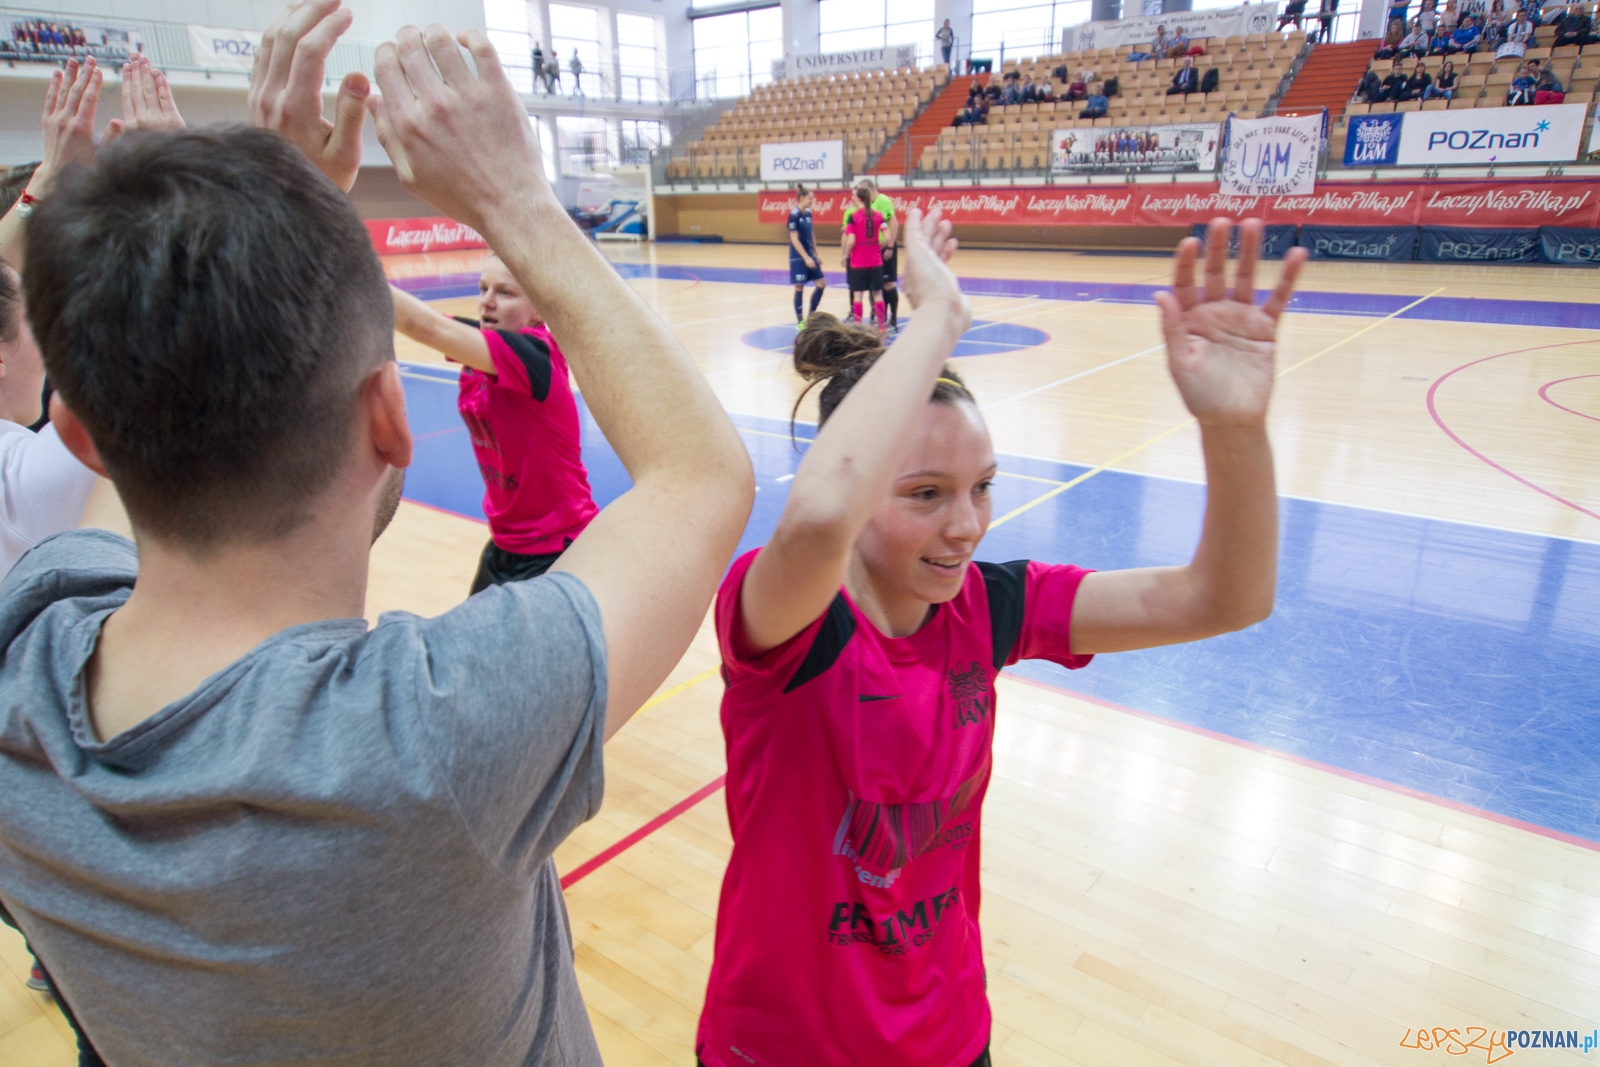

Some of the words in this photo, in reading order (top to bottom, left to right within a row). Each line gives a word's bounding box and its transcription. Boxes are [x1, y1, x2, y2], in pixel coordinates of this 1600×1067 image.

[1263, 126, 1272, 134] TO
[1353, 142, 1387, 160] UAM
[1242, 142, 1292, 178] UAM
[1257, 185, 1269, 194] TO
